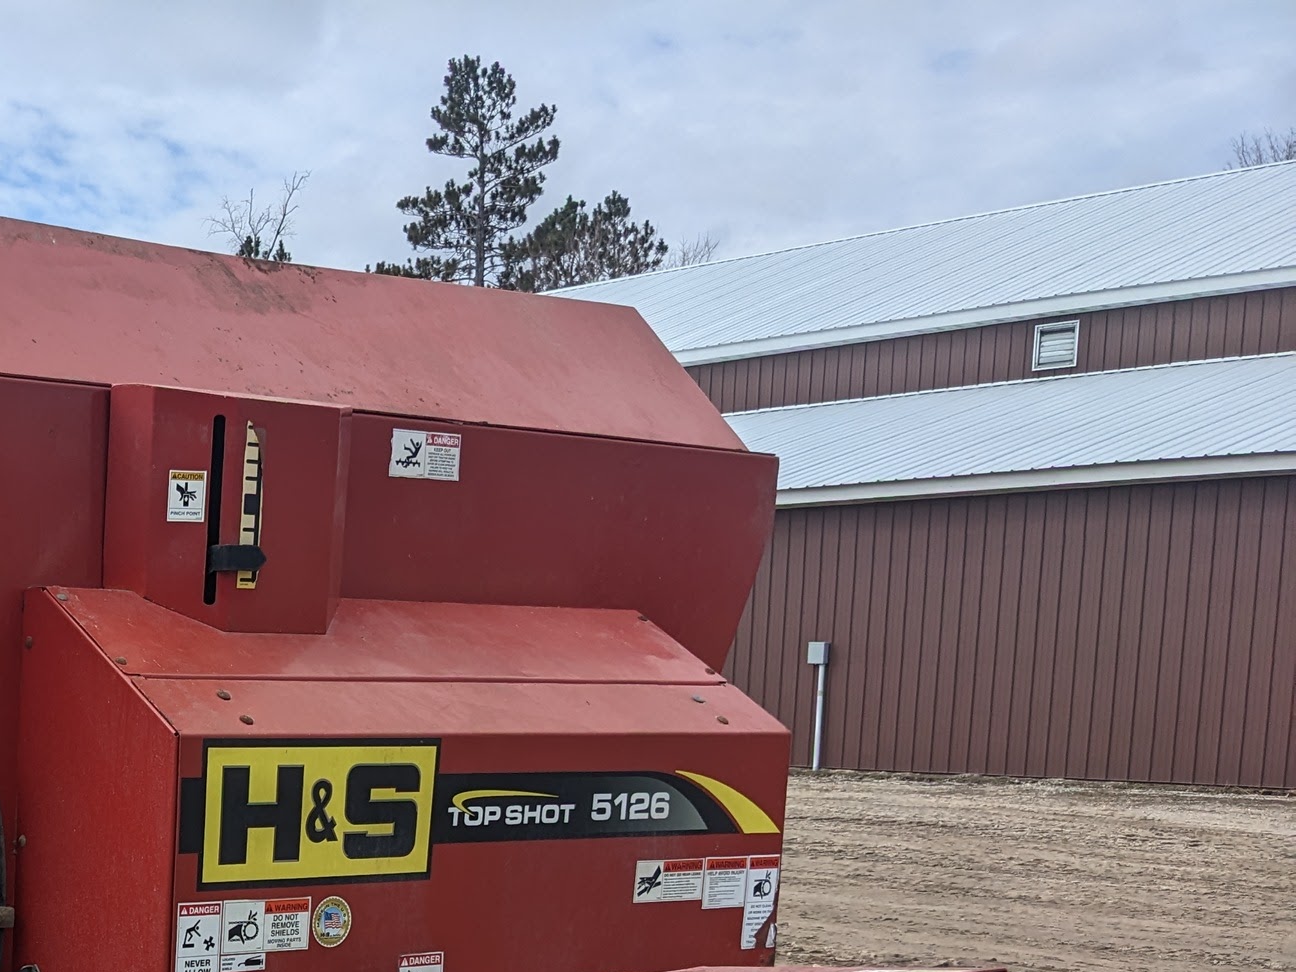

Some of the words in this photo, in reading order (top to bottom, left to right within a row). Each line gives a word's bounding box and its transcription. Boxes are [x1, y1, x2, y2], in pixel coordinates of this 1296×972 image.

[434, 436, 459, 446] DANGER
[218, 762, 421, 865] H&S
[448, 804, 501, 827] TOP
[505, 803, 575, 825] SHOT
[590, 792, 670, 821] 5126
[672, 861, 702, 870] WARNING
[716, 860, 744, 868] WARNING
[189, 905, 220, 914] DANGER
[274, 903, 308, 911] WARNING
[273, 914, 283, 922] DO
[272, 921, 300, 929] REMOVE
[270, 928, 300, 937] SHIELDS
[184, 959, 210, 968] NEVER
[409, 955, 440, 966] DANGER
